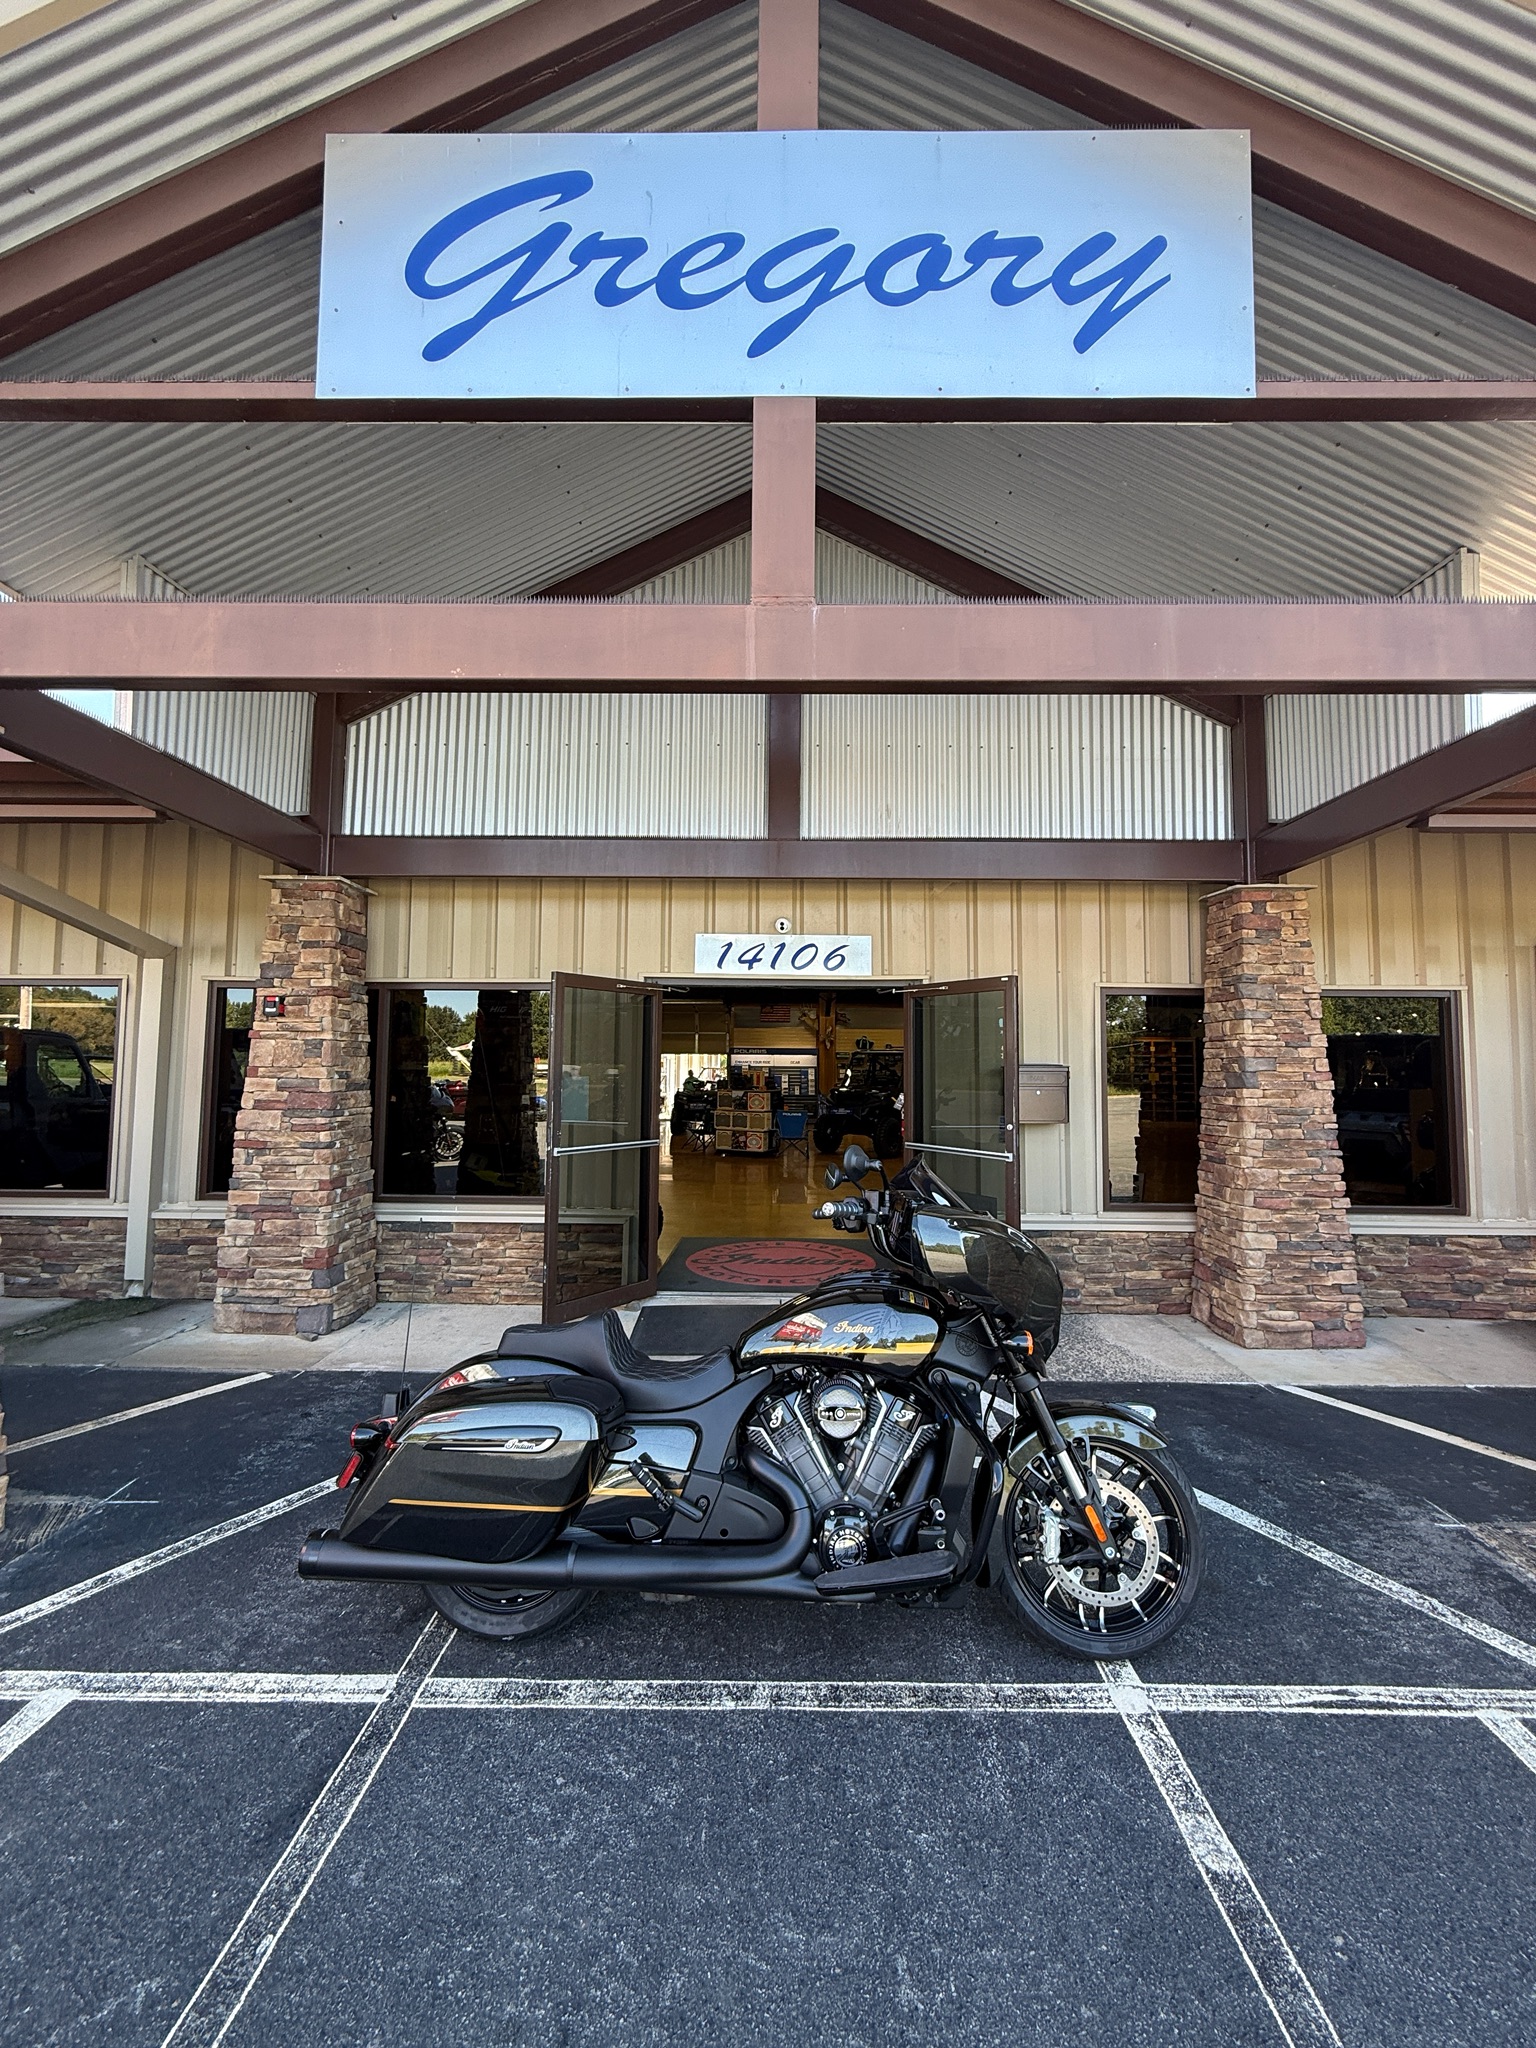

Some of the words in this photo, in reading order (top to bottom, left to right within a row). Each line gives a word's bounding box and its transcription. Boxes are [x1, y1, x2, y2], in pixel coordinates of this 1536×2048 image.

[404, 169, 1172, 363] Gregory
[716, 941, 850, 972] 14106
[691, 1253, 866, 1265] Indian
[833, 1320, 874, 1334] Indian
[504, 1439, 535, 1450] Indian
